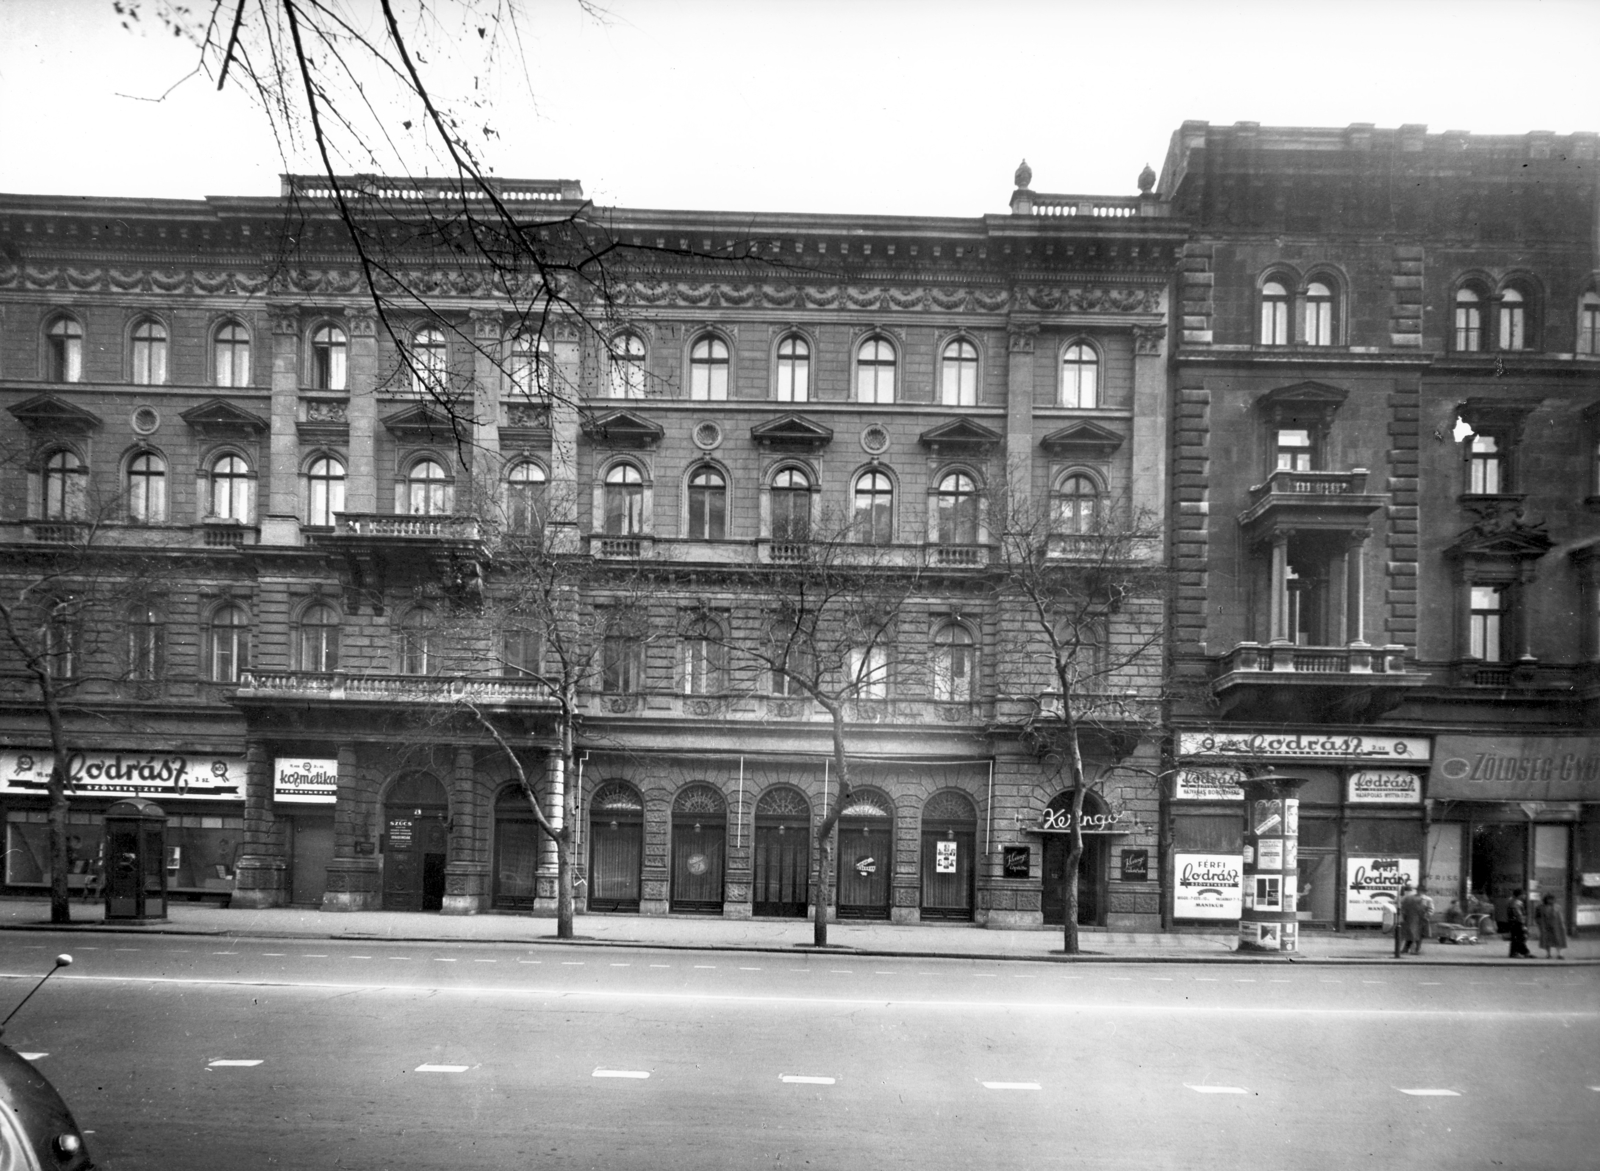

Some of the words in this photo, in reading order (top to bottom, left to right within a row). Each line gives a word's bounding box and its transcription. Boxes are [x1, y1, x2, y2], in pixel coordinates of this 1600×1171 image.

[280, 770, 337, 788] kozmetika
[86, 784, 163, 793] SZÖVETKEZET
[1197, 859, 1226, 868] FÉRFI
[1179, 863, 1240, 889] fodrász
